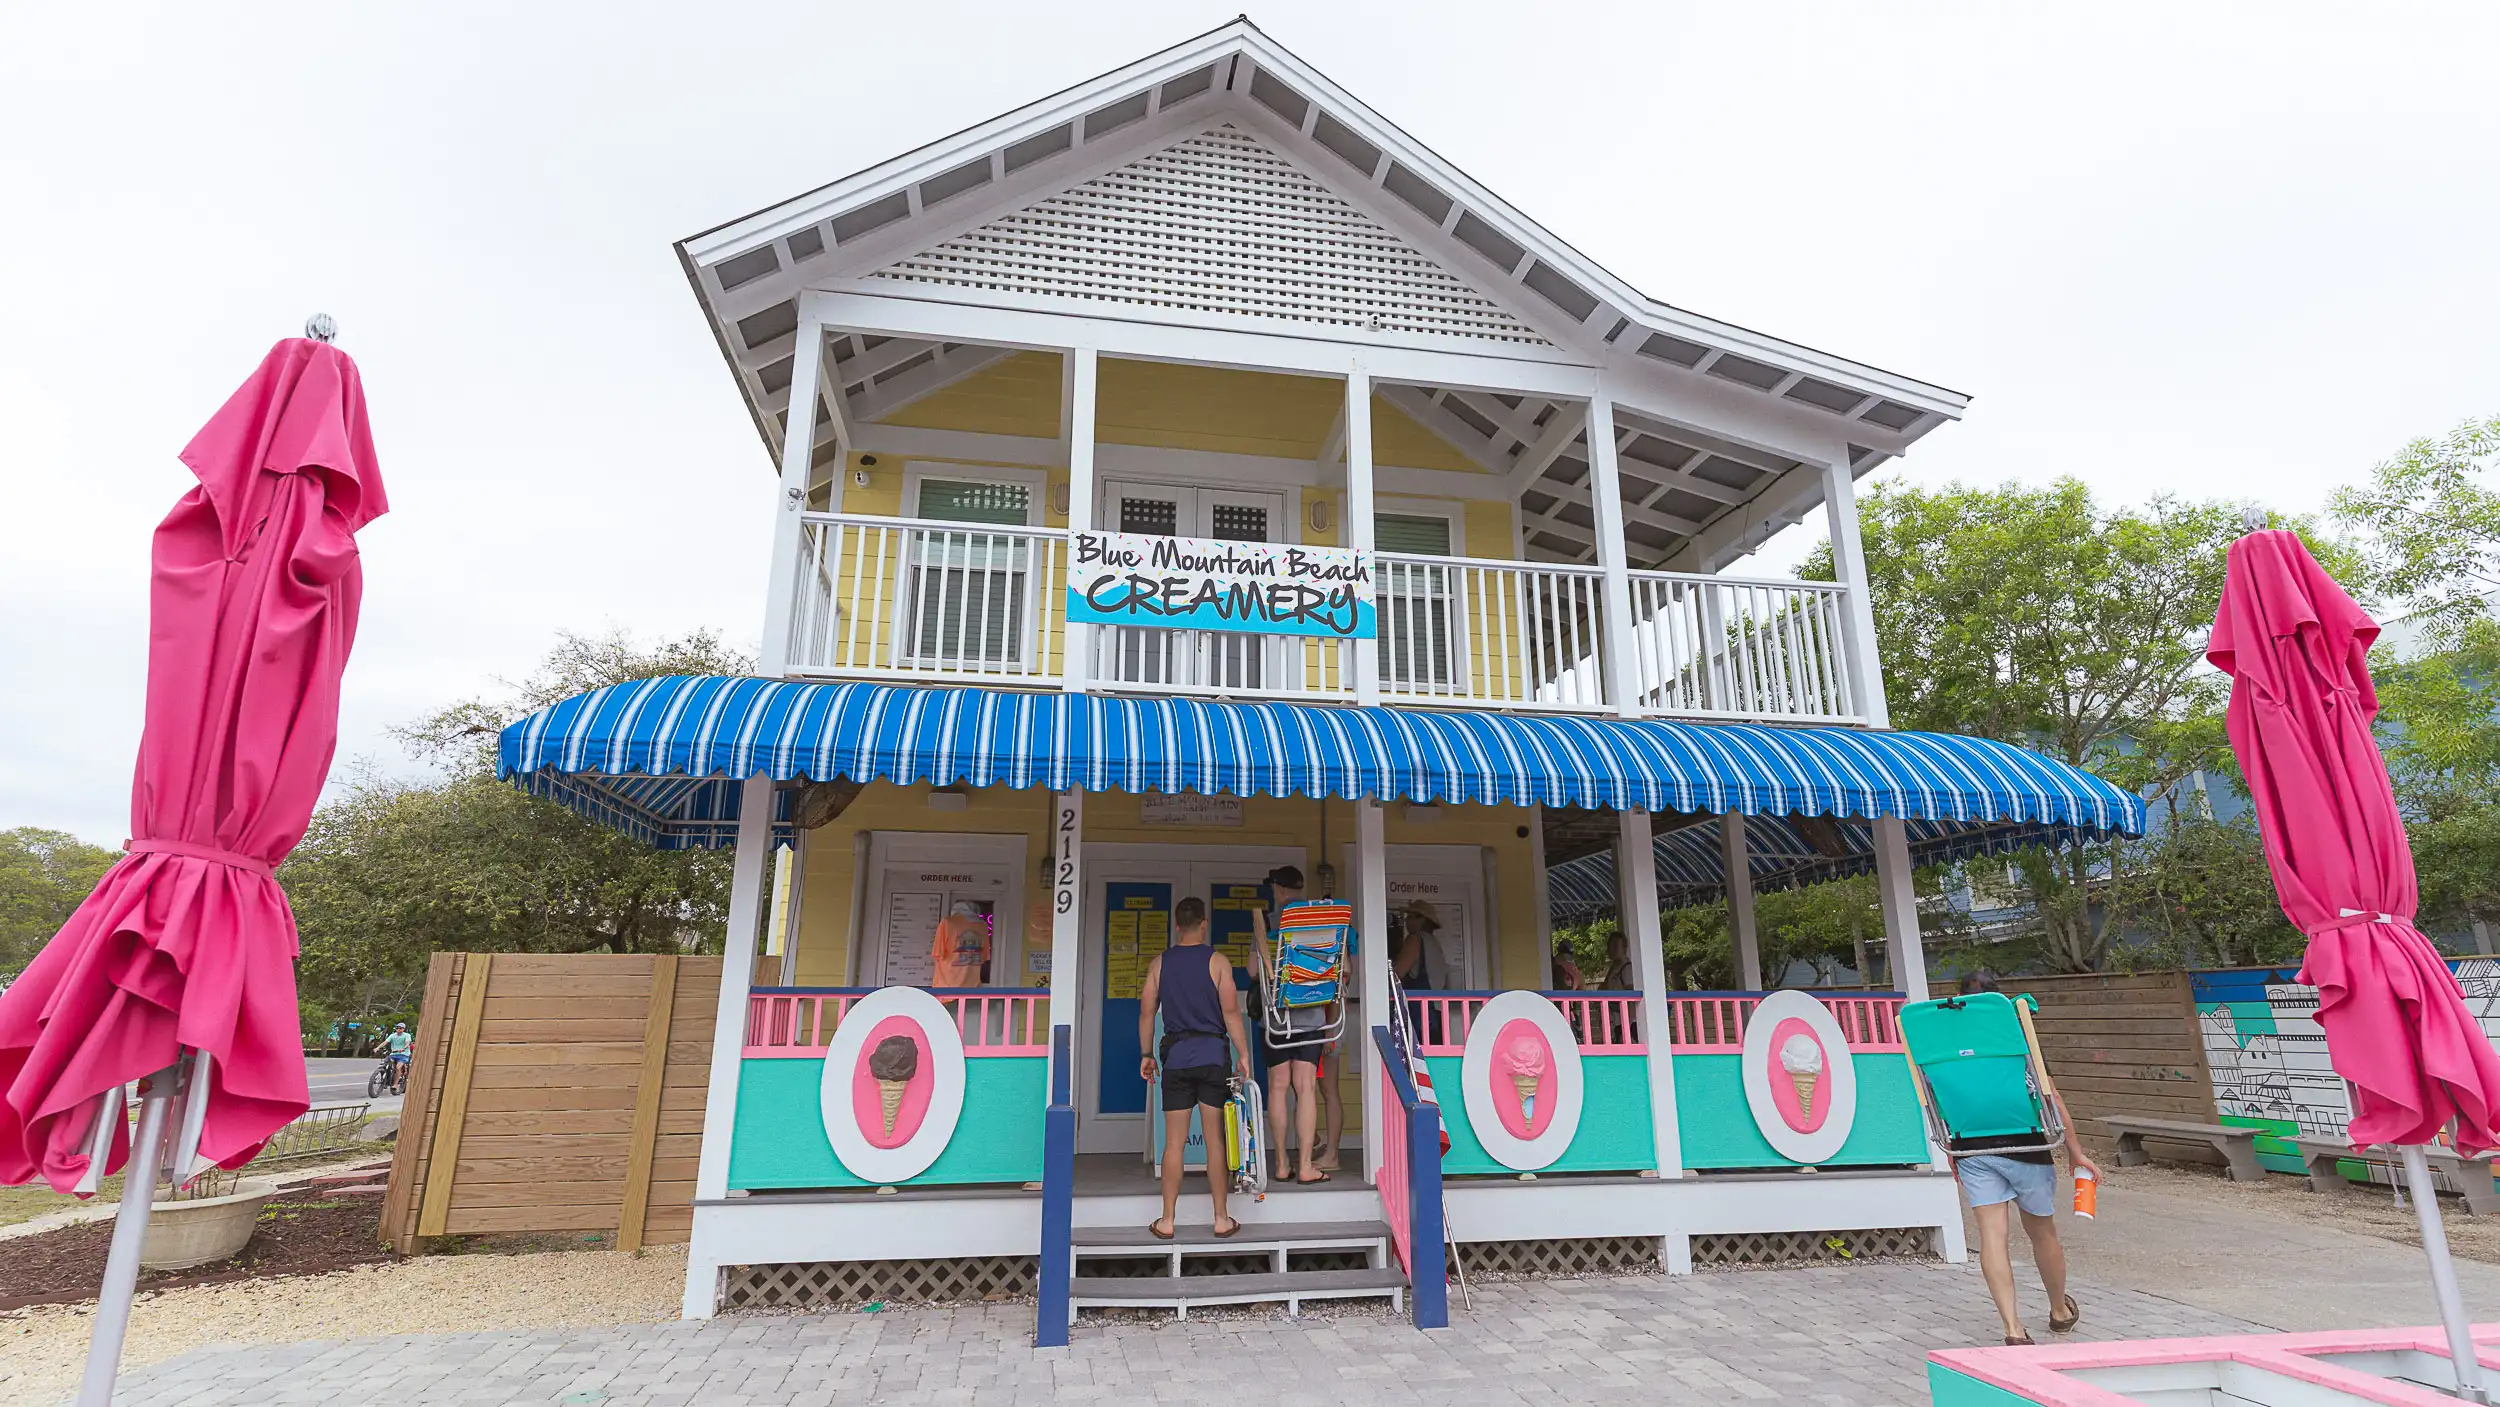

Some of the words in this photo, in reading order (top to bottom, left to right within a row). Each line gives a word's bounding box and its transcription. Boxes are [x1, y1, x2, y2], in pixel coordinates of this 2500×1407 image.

[1076, 533, 1142, 568] Blue
[1151, 538, 1275, 576] Mountain
[1286, 548, 1369, 583] Beach
[1086, 573, 1358, 635] CREAMERY
[920, 874, 949, 882] ORDER
[951, 875, 974, 883] HERE
[1057, 808, 1076, 914] 2129
[1389, 881, 1416, 893] Order
[1418, 881, 1439, 894] Here
